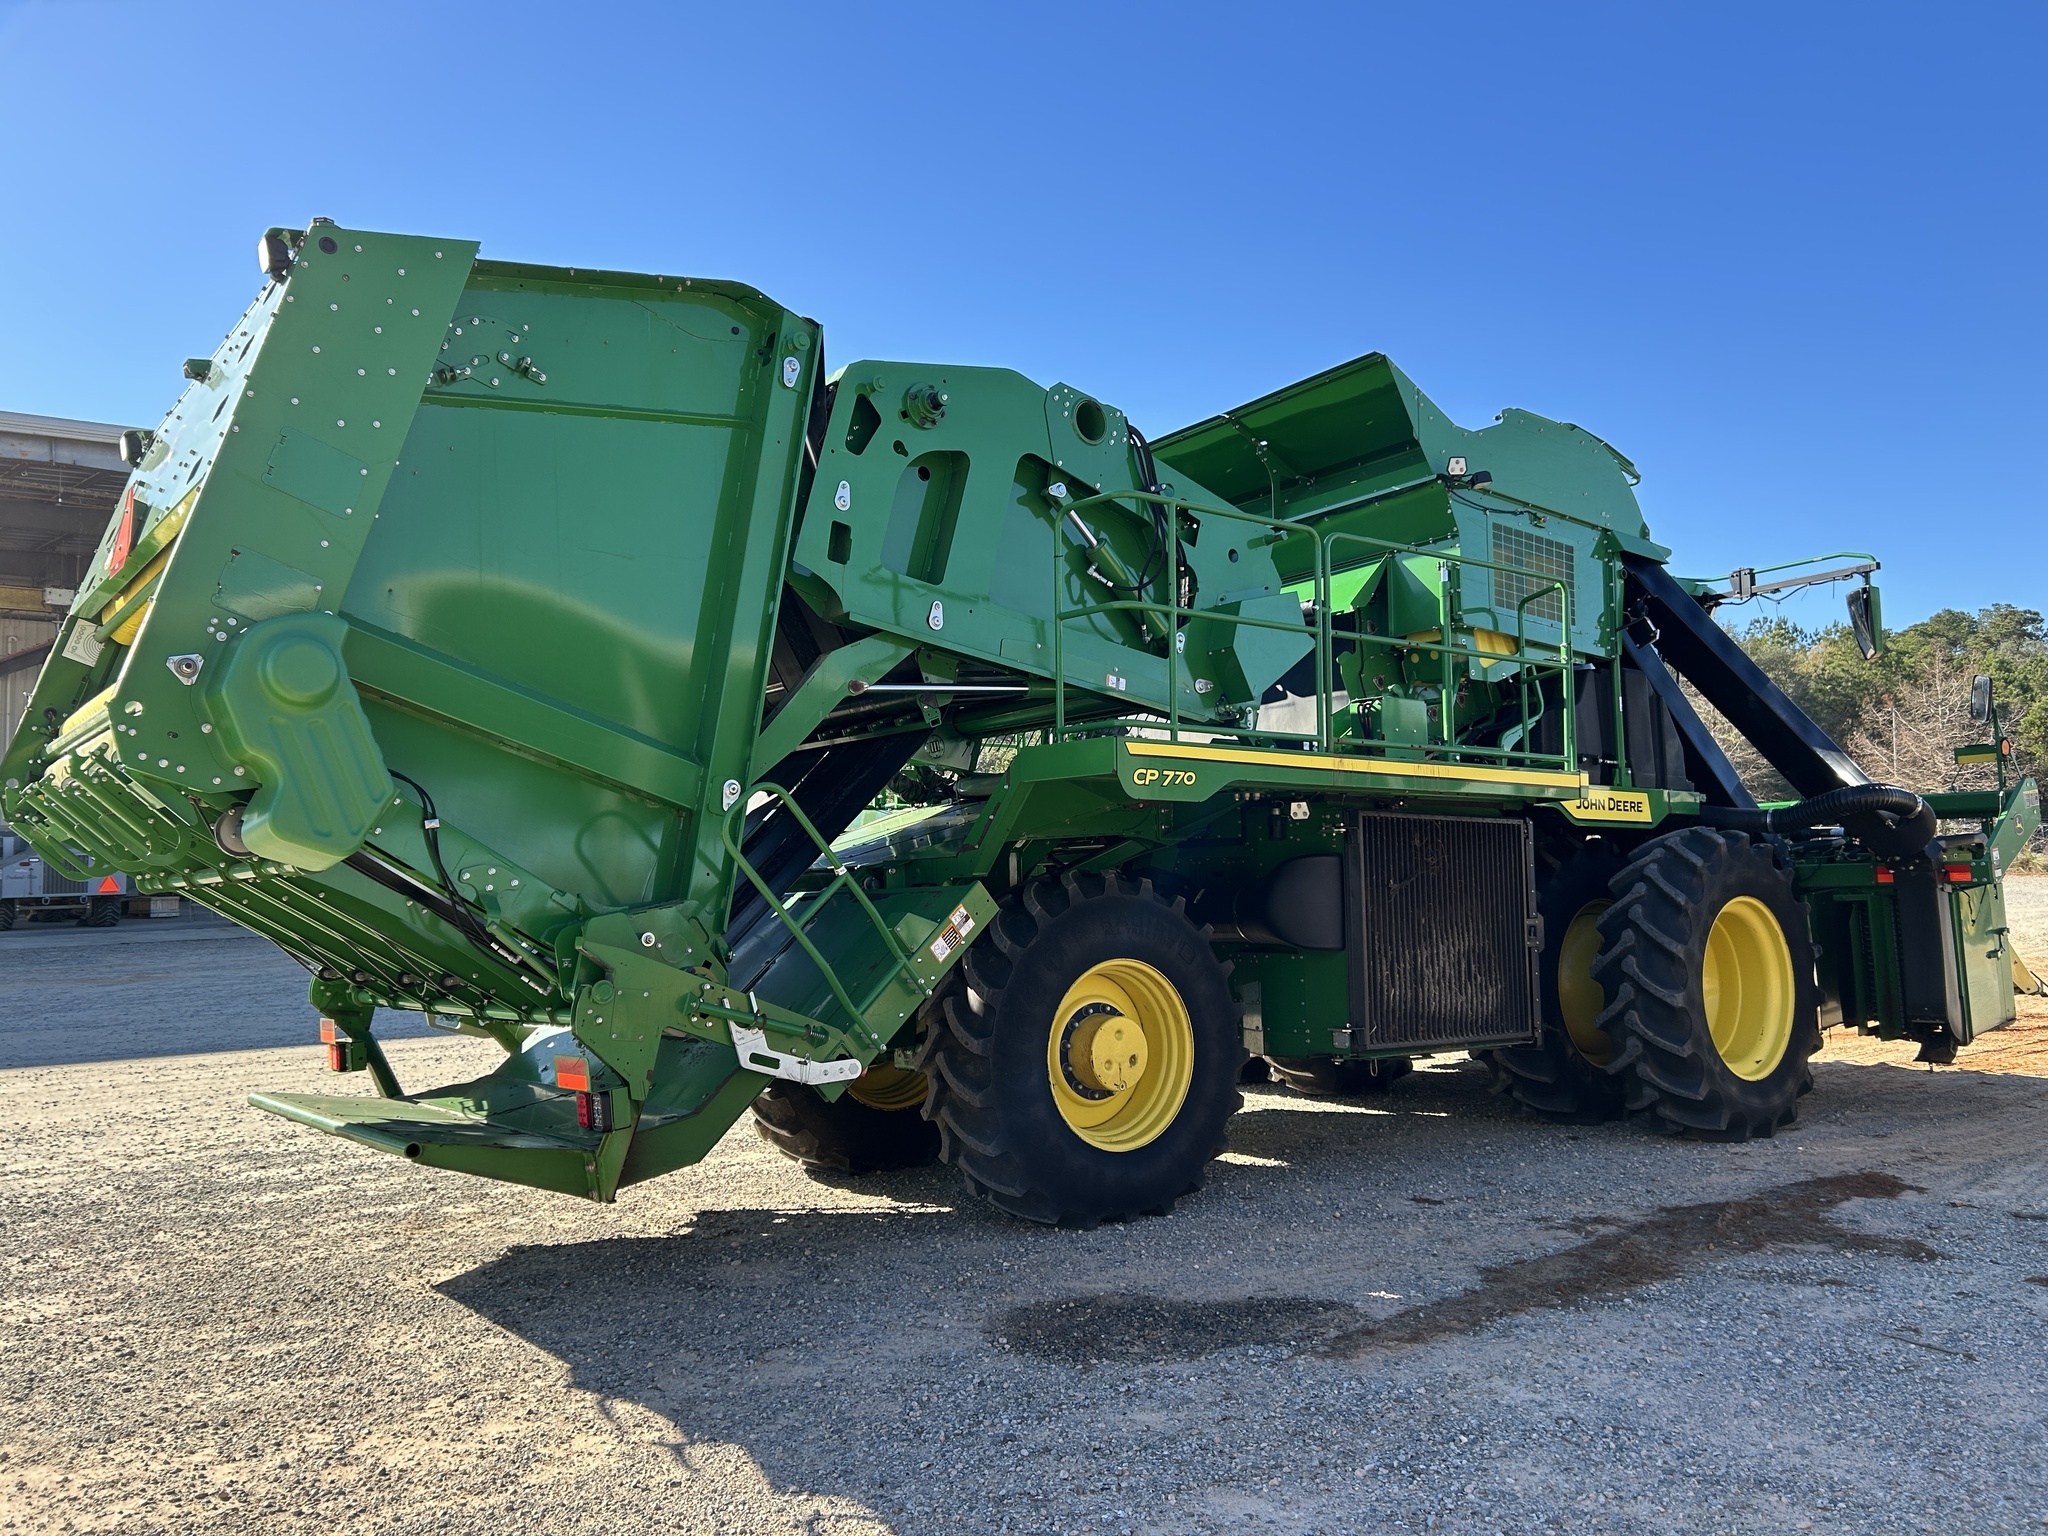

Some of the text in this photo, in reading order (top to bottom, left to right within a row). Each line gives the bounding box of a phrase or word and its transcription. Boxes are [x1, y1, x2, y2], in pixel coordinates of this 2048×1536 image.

[1133, 768, 1197, 787] CP 770
[1576, 797, 1643, 813] JOHN DEERE
